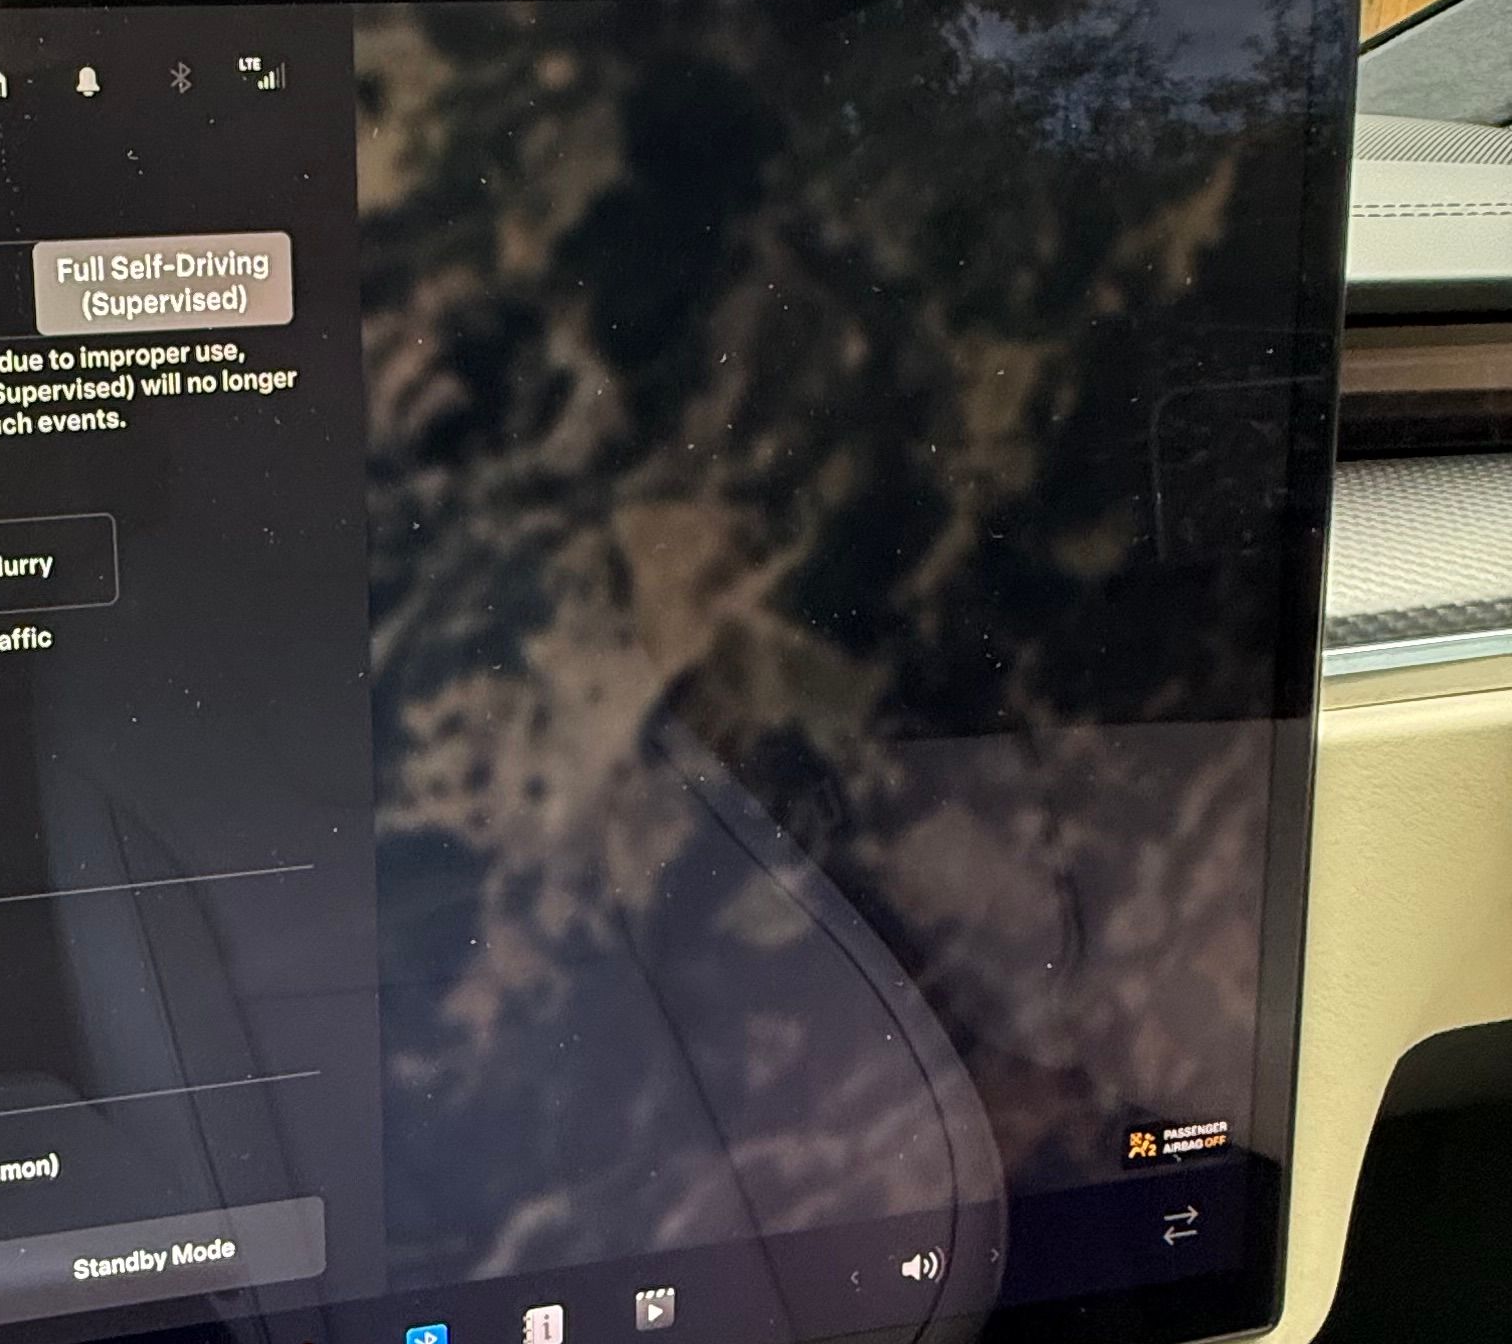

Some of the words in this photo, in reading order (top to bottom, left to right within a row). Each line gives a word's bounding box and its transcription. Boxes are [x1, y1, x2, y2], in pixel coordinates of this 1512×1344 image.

[238, 57, 262, 72] LTE
[58, 258, 104, 283] Full
[111, 254, 270, 281] Self-Driving
[81, 287, 248, 320] (Supervised)
[48, 349, 75, 371] to
[79, 345, 191, 372] improper
[195, 343, 245, 364] use,
[140, 372, 181, 396] will
[187, 375, 217, 394] no
[221, 369, 298, 395] longer
[37, 408, 127, 433] events.
[1162, 1138, 1204, 1154] AIRBAG
[1204, 1134, 1227, 1148] OFF
[1163, 1121, 1228, 1140] PASSENGER
[73, 1249, 168, 1280] Standby
[171, 1238, 236, 1266] Mode
